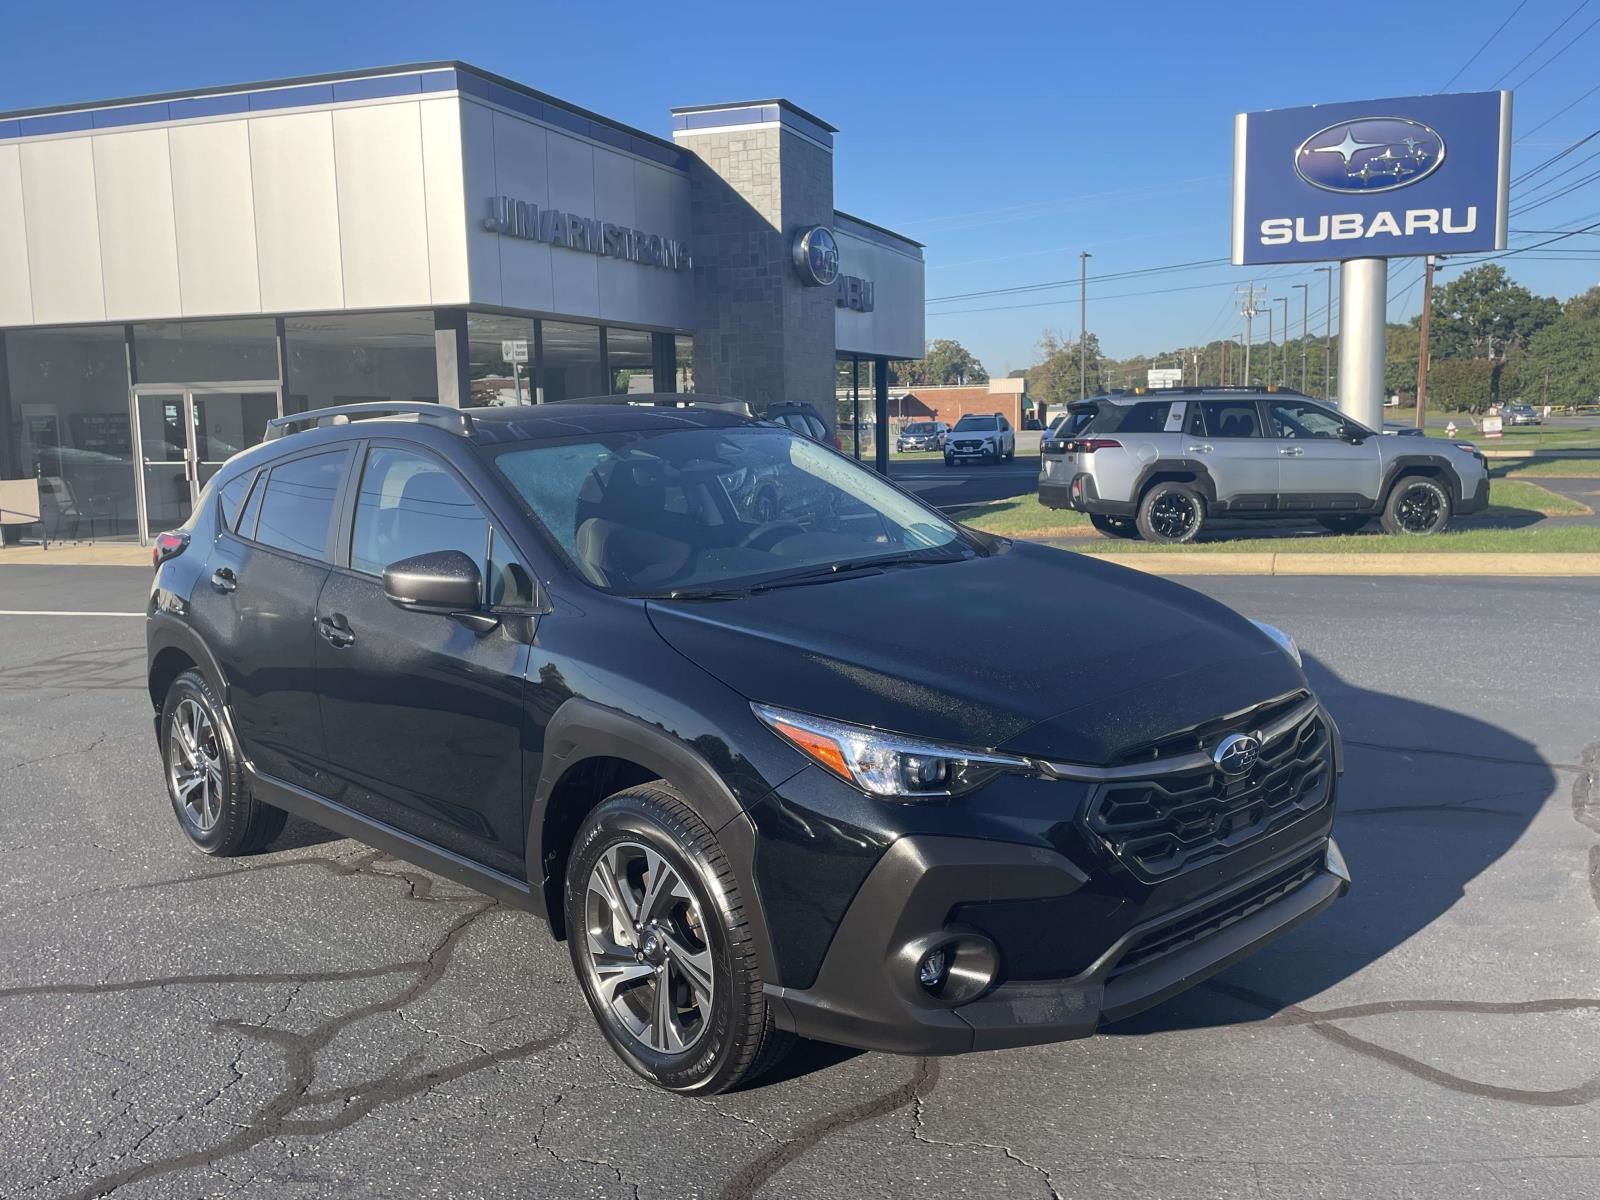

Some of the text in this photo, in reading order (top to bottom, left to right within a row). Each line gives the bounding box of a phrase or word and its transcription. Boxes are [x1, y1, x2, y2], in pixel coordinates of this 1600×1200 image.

[481, 195, 694, 271] JIM ARMSTRONG
[1260, 206, 1477, 245] SUBARU
[834, 272, 874, 313] ARU
